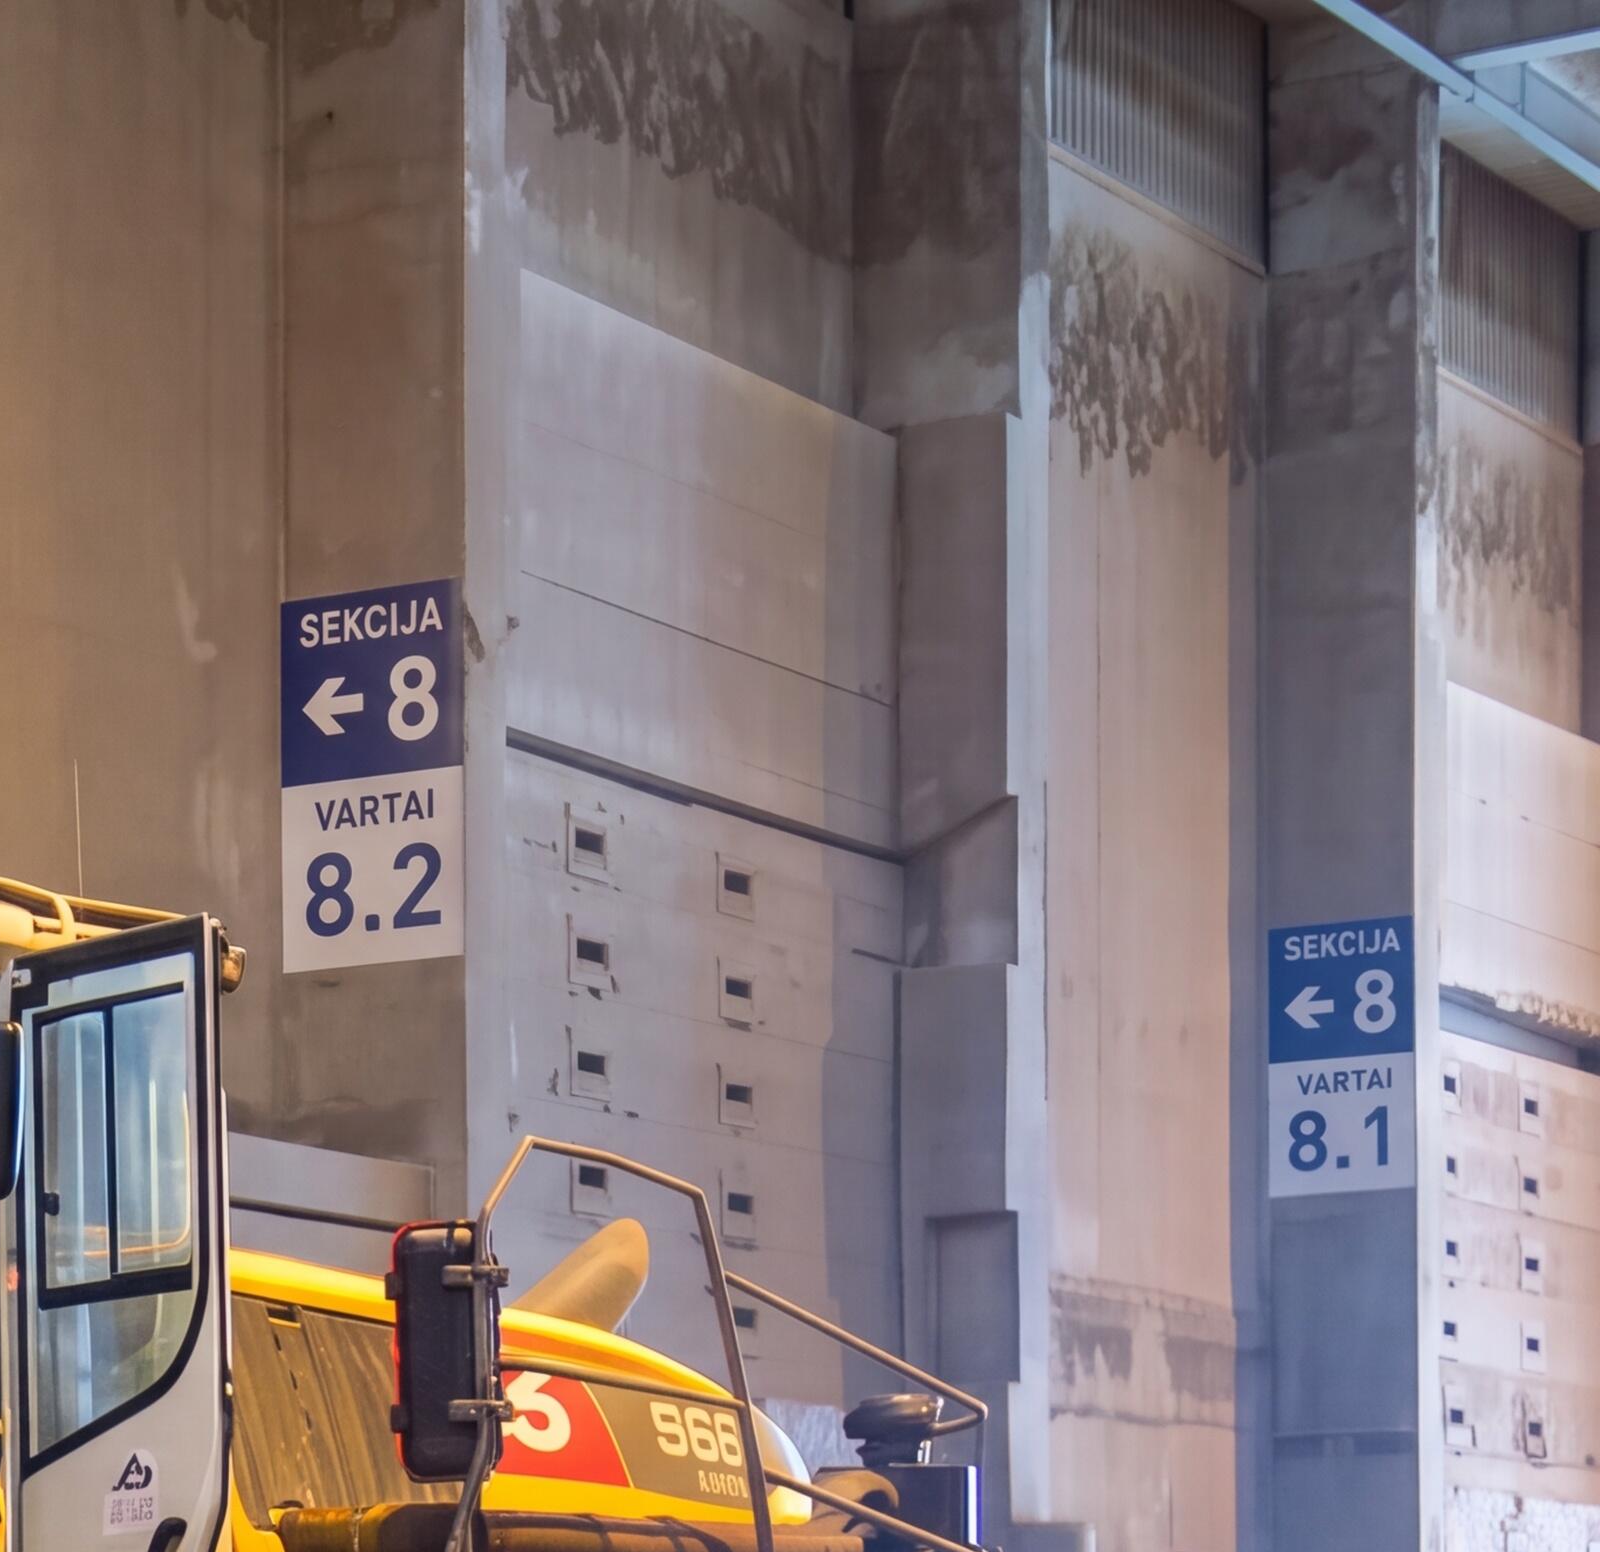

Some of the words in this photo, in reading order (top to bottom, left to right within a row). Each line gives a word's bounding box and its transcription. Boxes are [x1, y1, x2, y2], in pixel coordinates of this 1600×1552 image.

[300, 597, 443, 649] SEKCIJA
[387, 655, 439, 742] 8
[314, 788, 434, 832] VARTAI
[305, 842, 442, 938] 8.2
[1284, 928, 1400, 961] SEKCIJA
[1353, 969, 1397, 1034] 8
[1297, 1068, 1393, 1096] VARTAI
[1288, 1105, 1389, 1172] 8.1
[649, 1401, 743, 1467] 566
